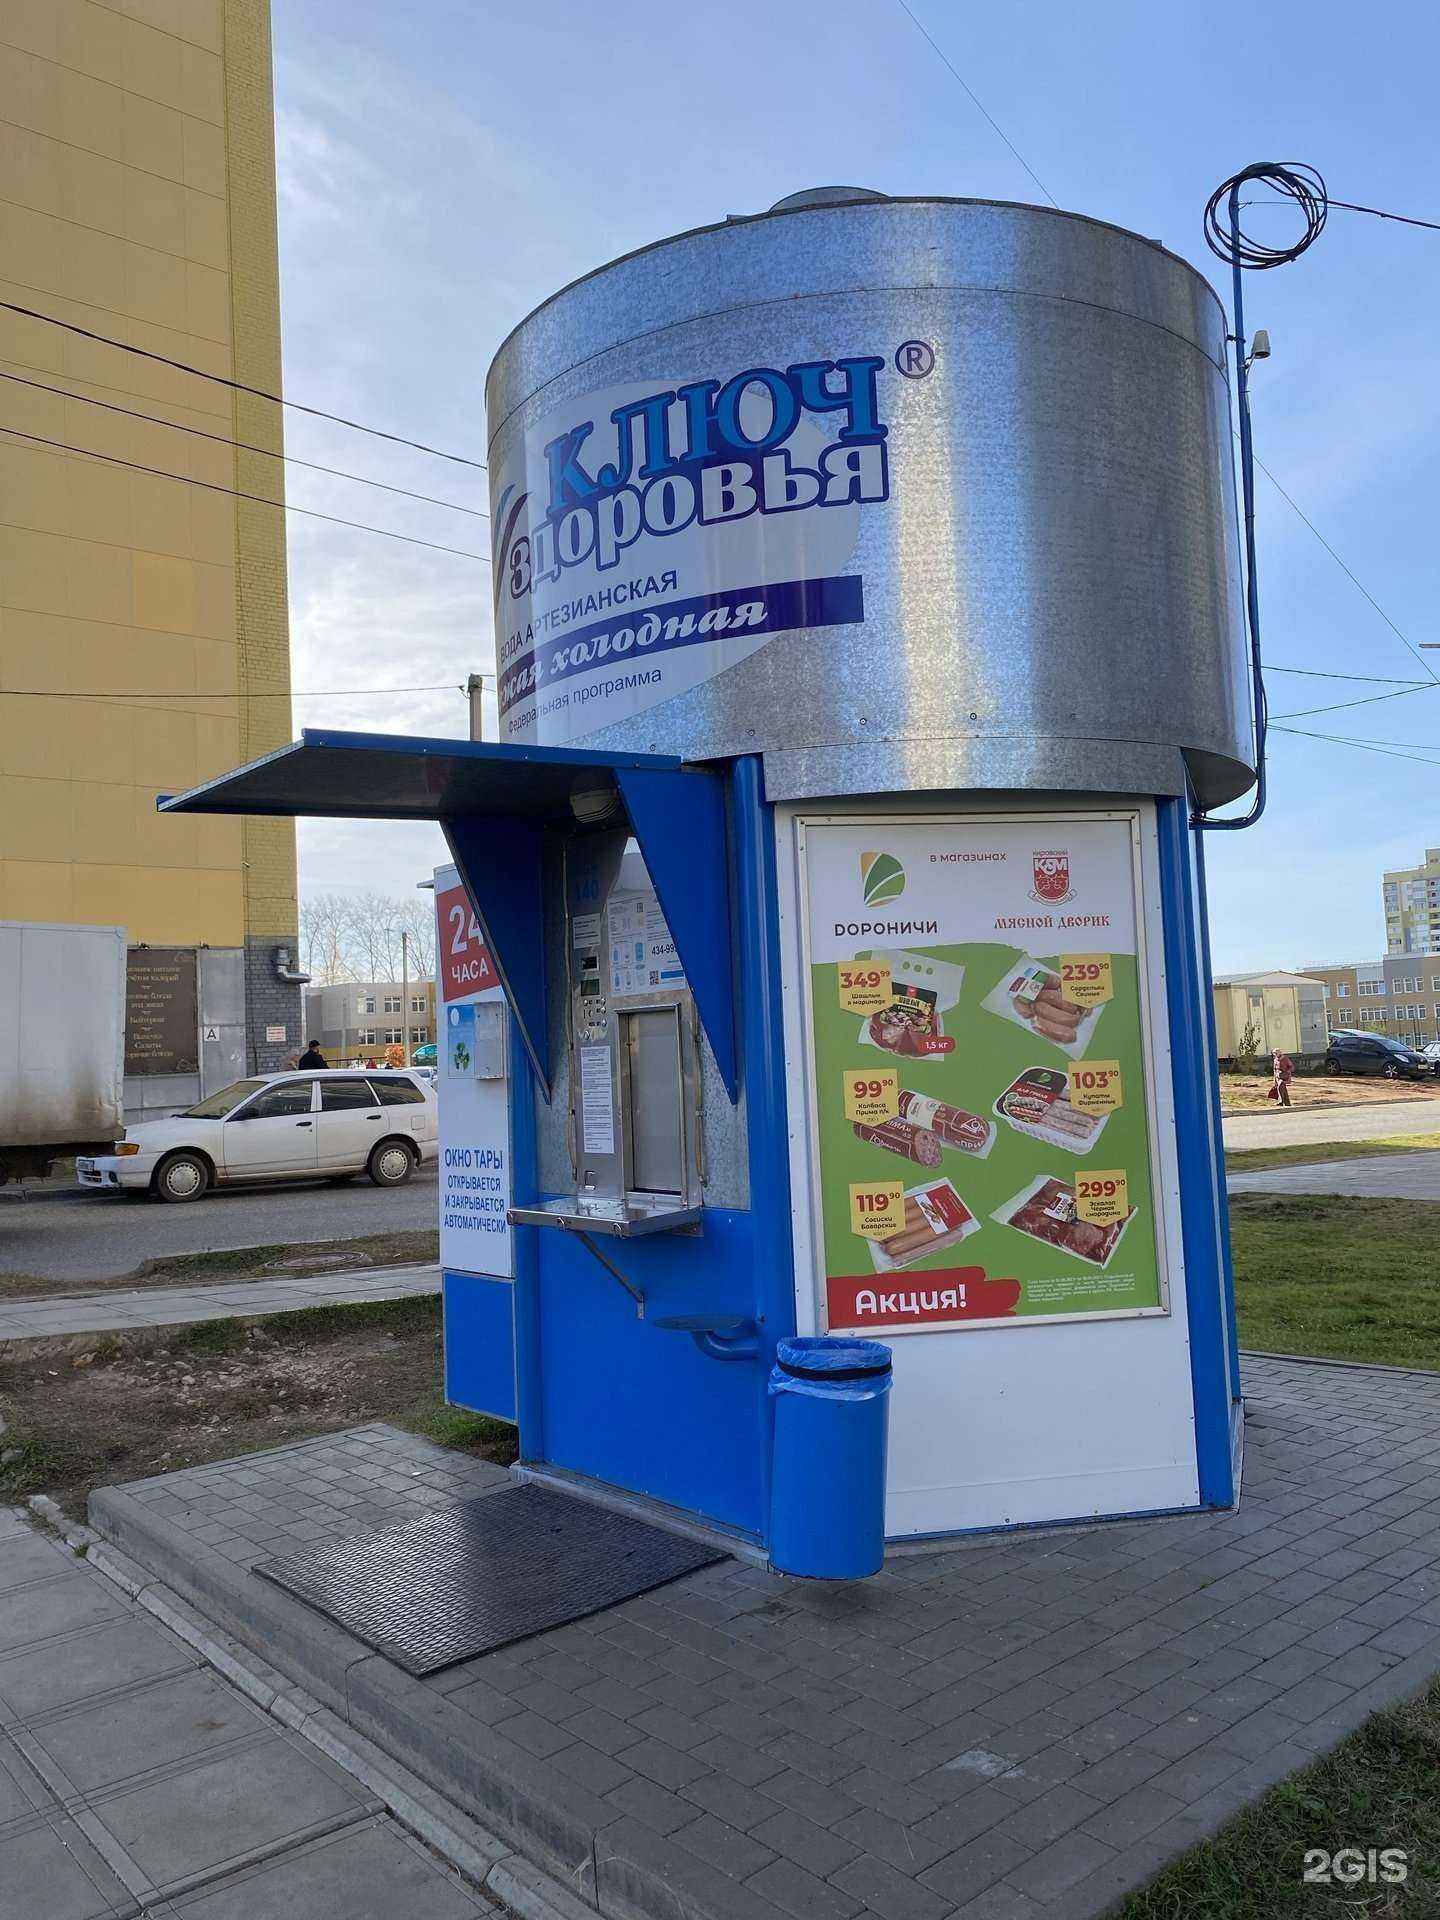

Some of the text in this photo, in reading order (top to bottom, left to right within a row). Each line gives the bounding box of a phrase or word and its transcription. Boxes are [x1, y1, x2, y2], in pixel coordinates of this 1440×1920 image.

[544, 356, 889, 512] КЛЮЧ
[501, 571, 677, 663] ВОДА АРТЕЗИАНСКАЯ
[551, 601, 768, 674] холодная
[573, 669, 662, 704] программа
[940, 852, 1006, 863] магазинах
[449, 904, 484, 955] 24
[651, 943, 679, 956] 434-99
[452, 957, 489, 984] ЧАСА
[840, 971, 881, 989] 349
[1062, 964, 1100, 981] 239
[854, 1080, 882, 1099] 99
[1072, 1071, 1109, 1089] 103
[445, 1148, 503, 1170] ОКНО ТАРЫ
[447, 1174, 501, 1192] ОТКРЫВАЕТСЯ
[1078, 1180, 1116, 1198] 299
[451, 1194, 505, 1213] ЗАКРЫВАЕТСЯ
[856, 1193, 889, 1212] 119
[444, 1214, 507, 1234] АВТОМАТИЧЕСКИ
[855, 1283, 966, 1315] Акция!
